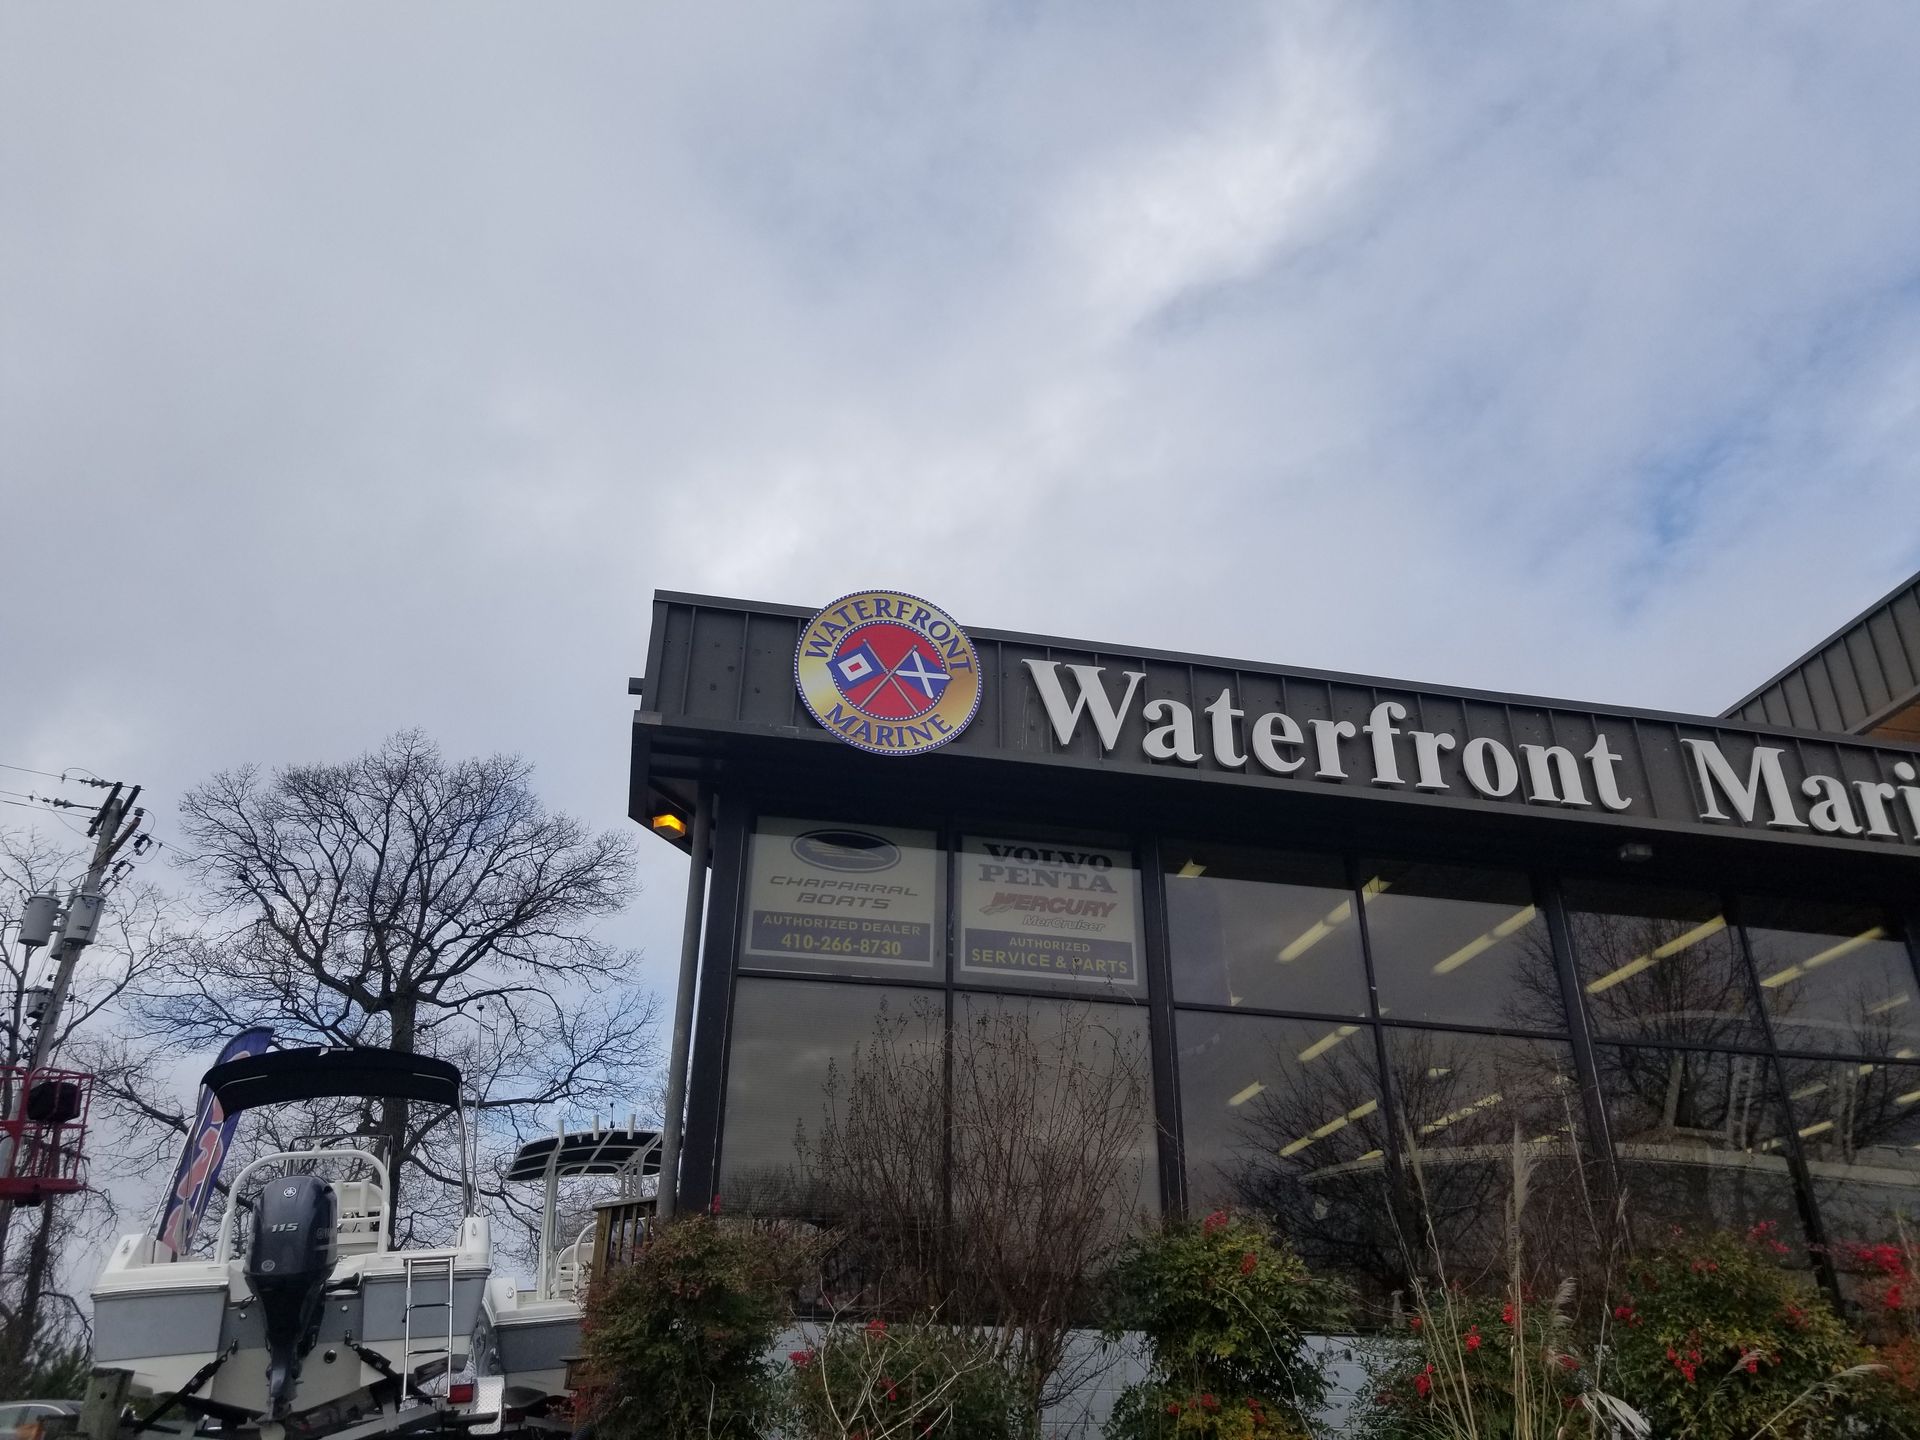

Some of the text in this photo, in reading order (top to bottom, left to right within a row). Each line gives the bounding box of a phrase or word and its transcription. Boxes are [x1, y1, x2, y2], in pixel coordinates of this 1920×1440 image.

[804, 597, 973, 674] WATERFRONT
[823, 702, 954, 748] MARINE
[1020, 658, 1920, 840] Waterfront Mari
[982, 843, 1113, 873] VOLVO
[769, 875, 919, 897] CHAPARRAL
[978, 864, 1119, 894] PENTA
[797, 892, 892, 910] BOATS
[986, 892, 1118, 918] MERCURY
[762, 914, 921, 936] AUTHORIZED DEALER
[780, 932, 902, 956] 410-266-8730
[1009, 937, 1091, 953] AUTHORIZED
[971, 948, 1128, 974] SERVICE & PARTS
[271, 1222, 299, 1233] 115
